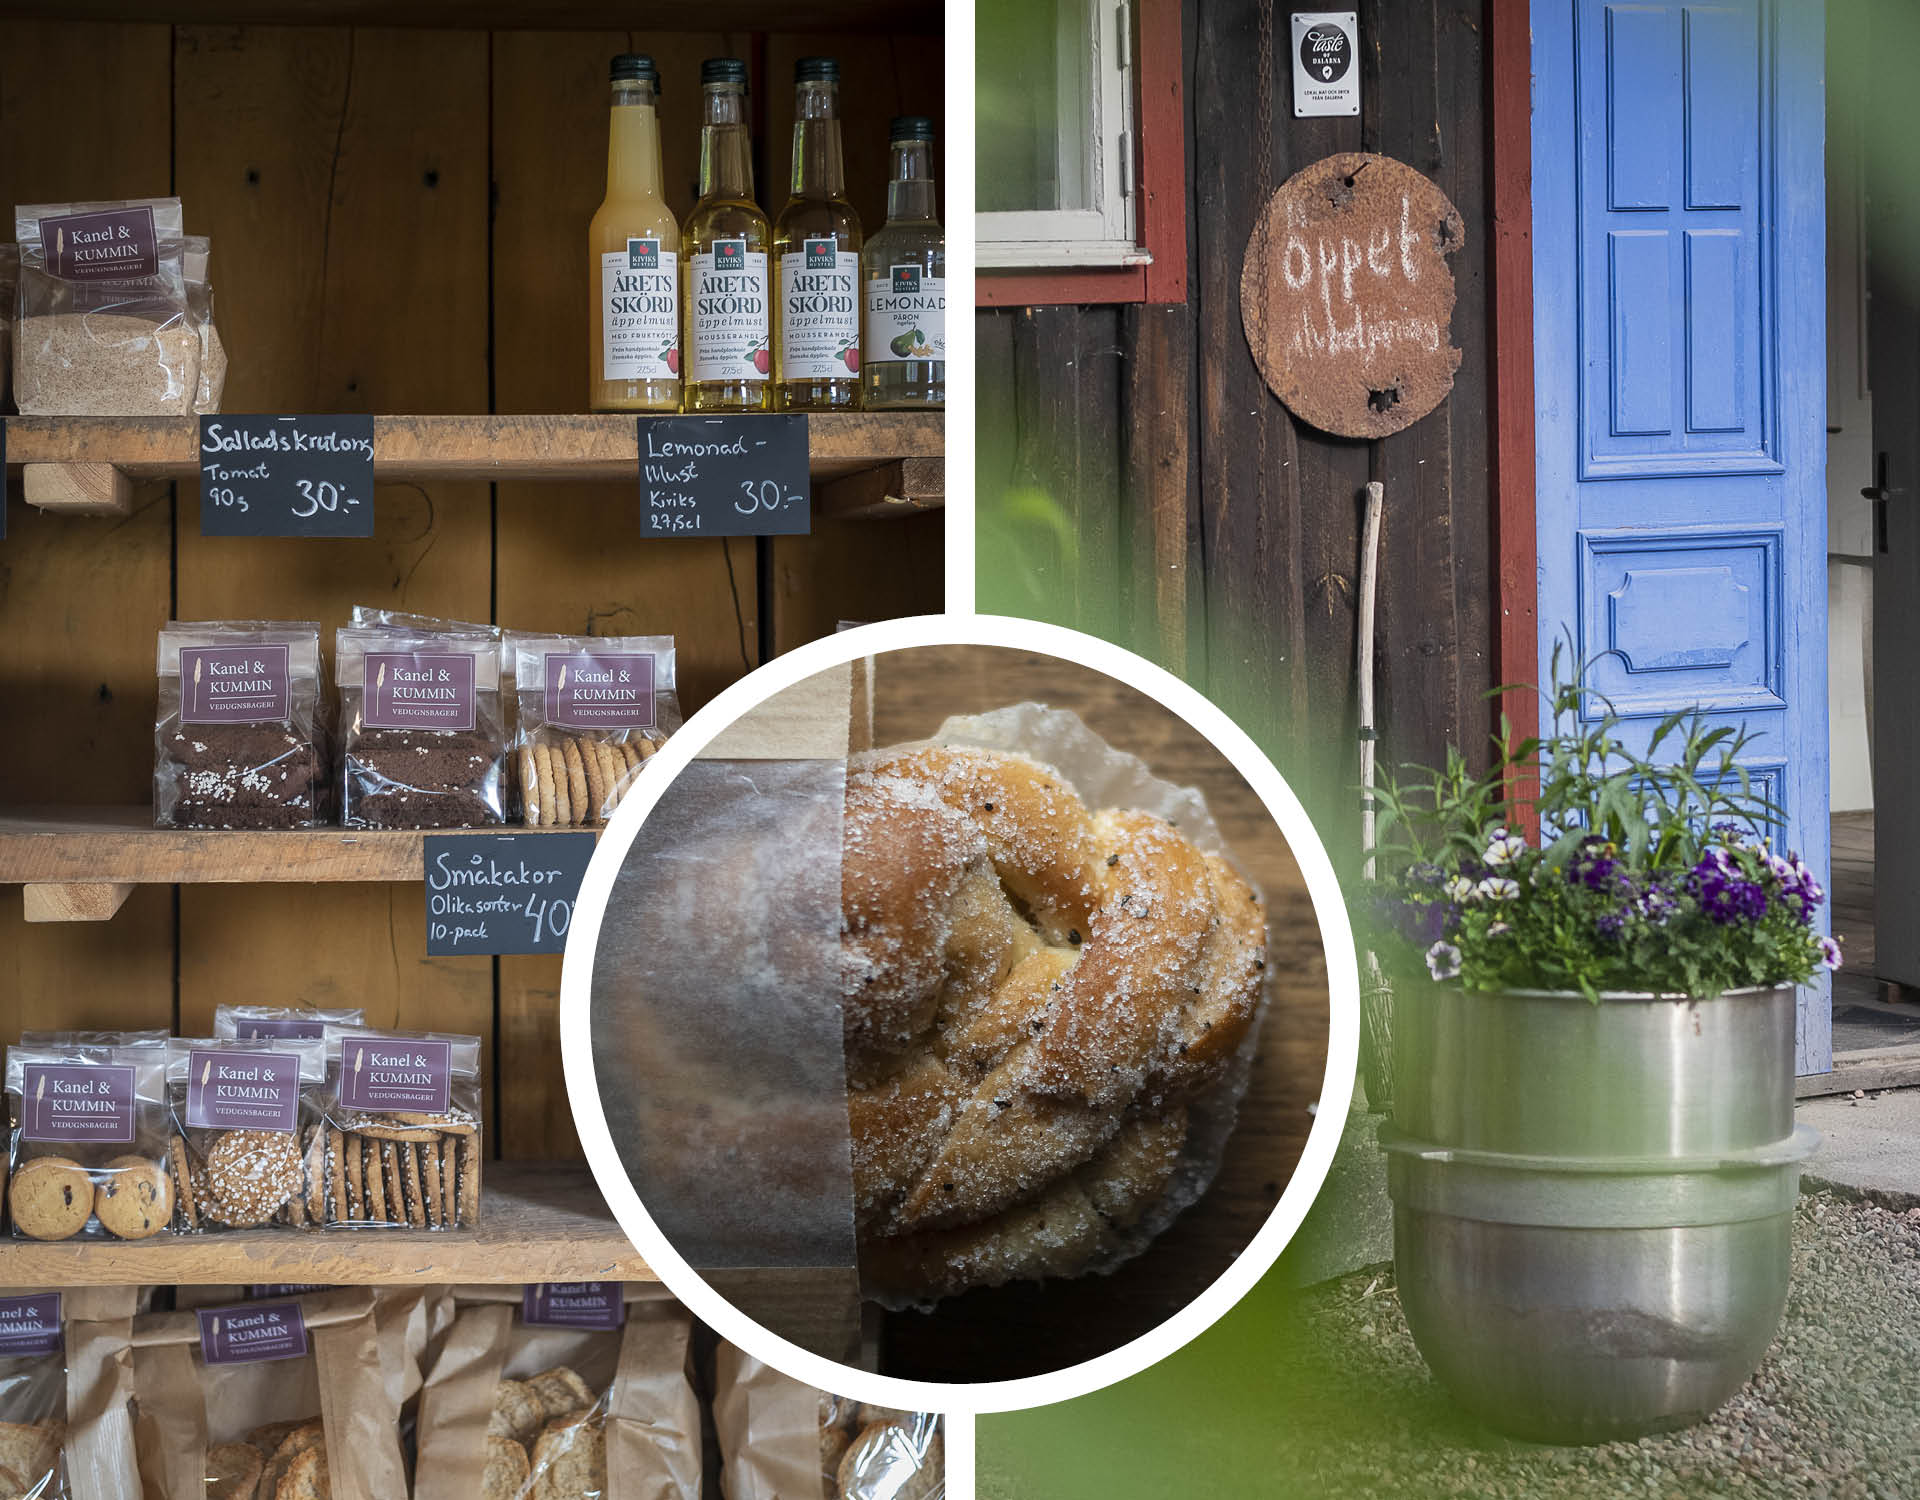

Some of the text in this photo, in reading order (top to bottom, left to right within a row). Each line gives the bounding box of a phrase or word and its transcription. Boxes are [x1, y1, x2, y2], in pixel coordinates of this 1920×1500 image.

[1308, 31, 1344, 52] Taste
[72, 225, 131, 245] Kanel &
[74, 244, 139, 262] KUMMIN
[632, 255, 657, 263] KIVIKS
[717, 256, 742, 264] KIVIKS
[809, 255, 833, 263] KIVIKS
[613, 270, 672, 292] ÅRETS
[700, 271, 760, 294] ÅRETS
[790, 270, 851, 293] ÅRETS
[611, 292, 673, 314] SKÖRD
[698, 293, 762, 316] SKÖRD
[789, 292, 853, 314] SKÖRD
[611, 315, 674, 328] äppelmust
[698, 316, 763, 329] äppelmust
[789, 315, 853, 328] äppelmust
[698, 333, 759, 341] MOUSSERANDE
[789, 332, 850, 340] MOUSSERANDE
[648, 433, 749, 457] Lemonad
[203, 462, 270, 480] Tomat
[645, 461, 699, 483] Must
[291, 480, 360, 517] 30:-
[734, 480, 803, 515] 30:-
[209, 660, 265, 675] Kanel &
[393, 668, 451, 682] Kanel &
[574, 669, 631, 683] Kanel &
[210, 679, 272, 694] KUMMIN
[392, 687, 456, 700] KUMMIN
[573, 689, 637, 700] KUMMIN
[209, 701, 275, 710] VEDUGNSBAGERI
[392, 709, 459, 717] VEDUGNSBAGERI
[429, 852, 562, 890] Småkakor
[430, 921, 488, 946] 10-pack
[370, 1053, 427, 1068] Kanel &
[218, 1066, 275, 1082] Kanel &
[370, 1072, 432, 1085] KUMMIN
[53, 1080, 111, 1094] Kanel &
[217, 1085, 280, 1099] KUMMIN
[368, 1092, 434, 1101] VEDUGNSBAGERI
[52, 1100, 116, 1112] KUMMIN
[215, 1107, 281, 1118] VEDUGNSBAGERI
[51, 1121, 118, 1129] VEDUGNSBAGERI
[0, 1306, 38, 1319] nel &
[0, 1320, 43, 1334] MMIN
[227, 1313, 281, 1329] Kanel &
[228, 1325, 288, 1343] KUMMIN
